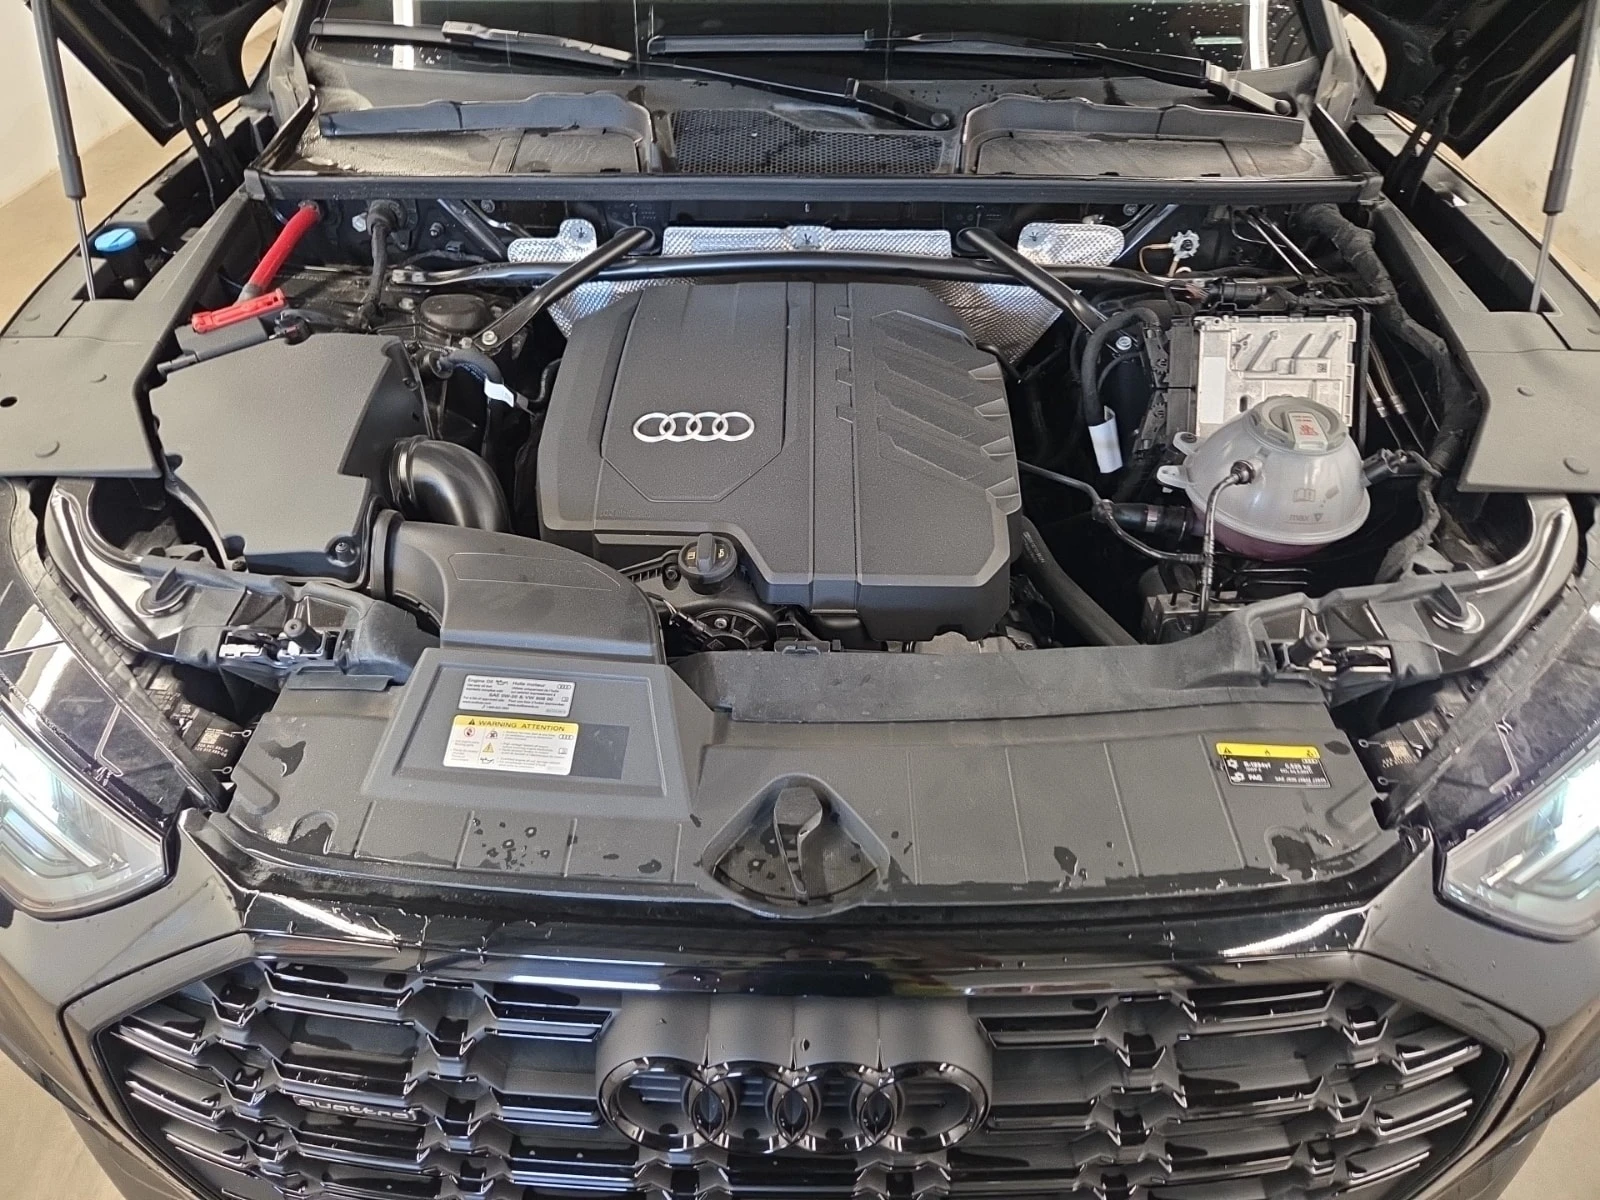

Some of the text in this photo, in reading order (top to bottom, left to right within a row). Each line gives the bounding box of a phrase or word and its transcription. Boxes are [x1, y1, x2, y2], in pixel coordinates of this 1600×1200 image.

[478, 720, 565, 732] WARNING ATTENTION
[299, 1099, 409, 1119] quattro
